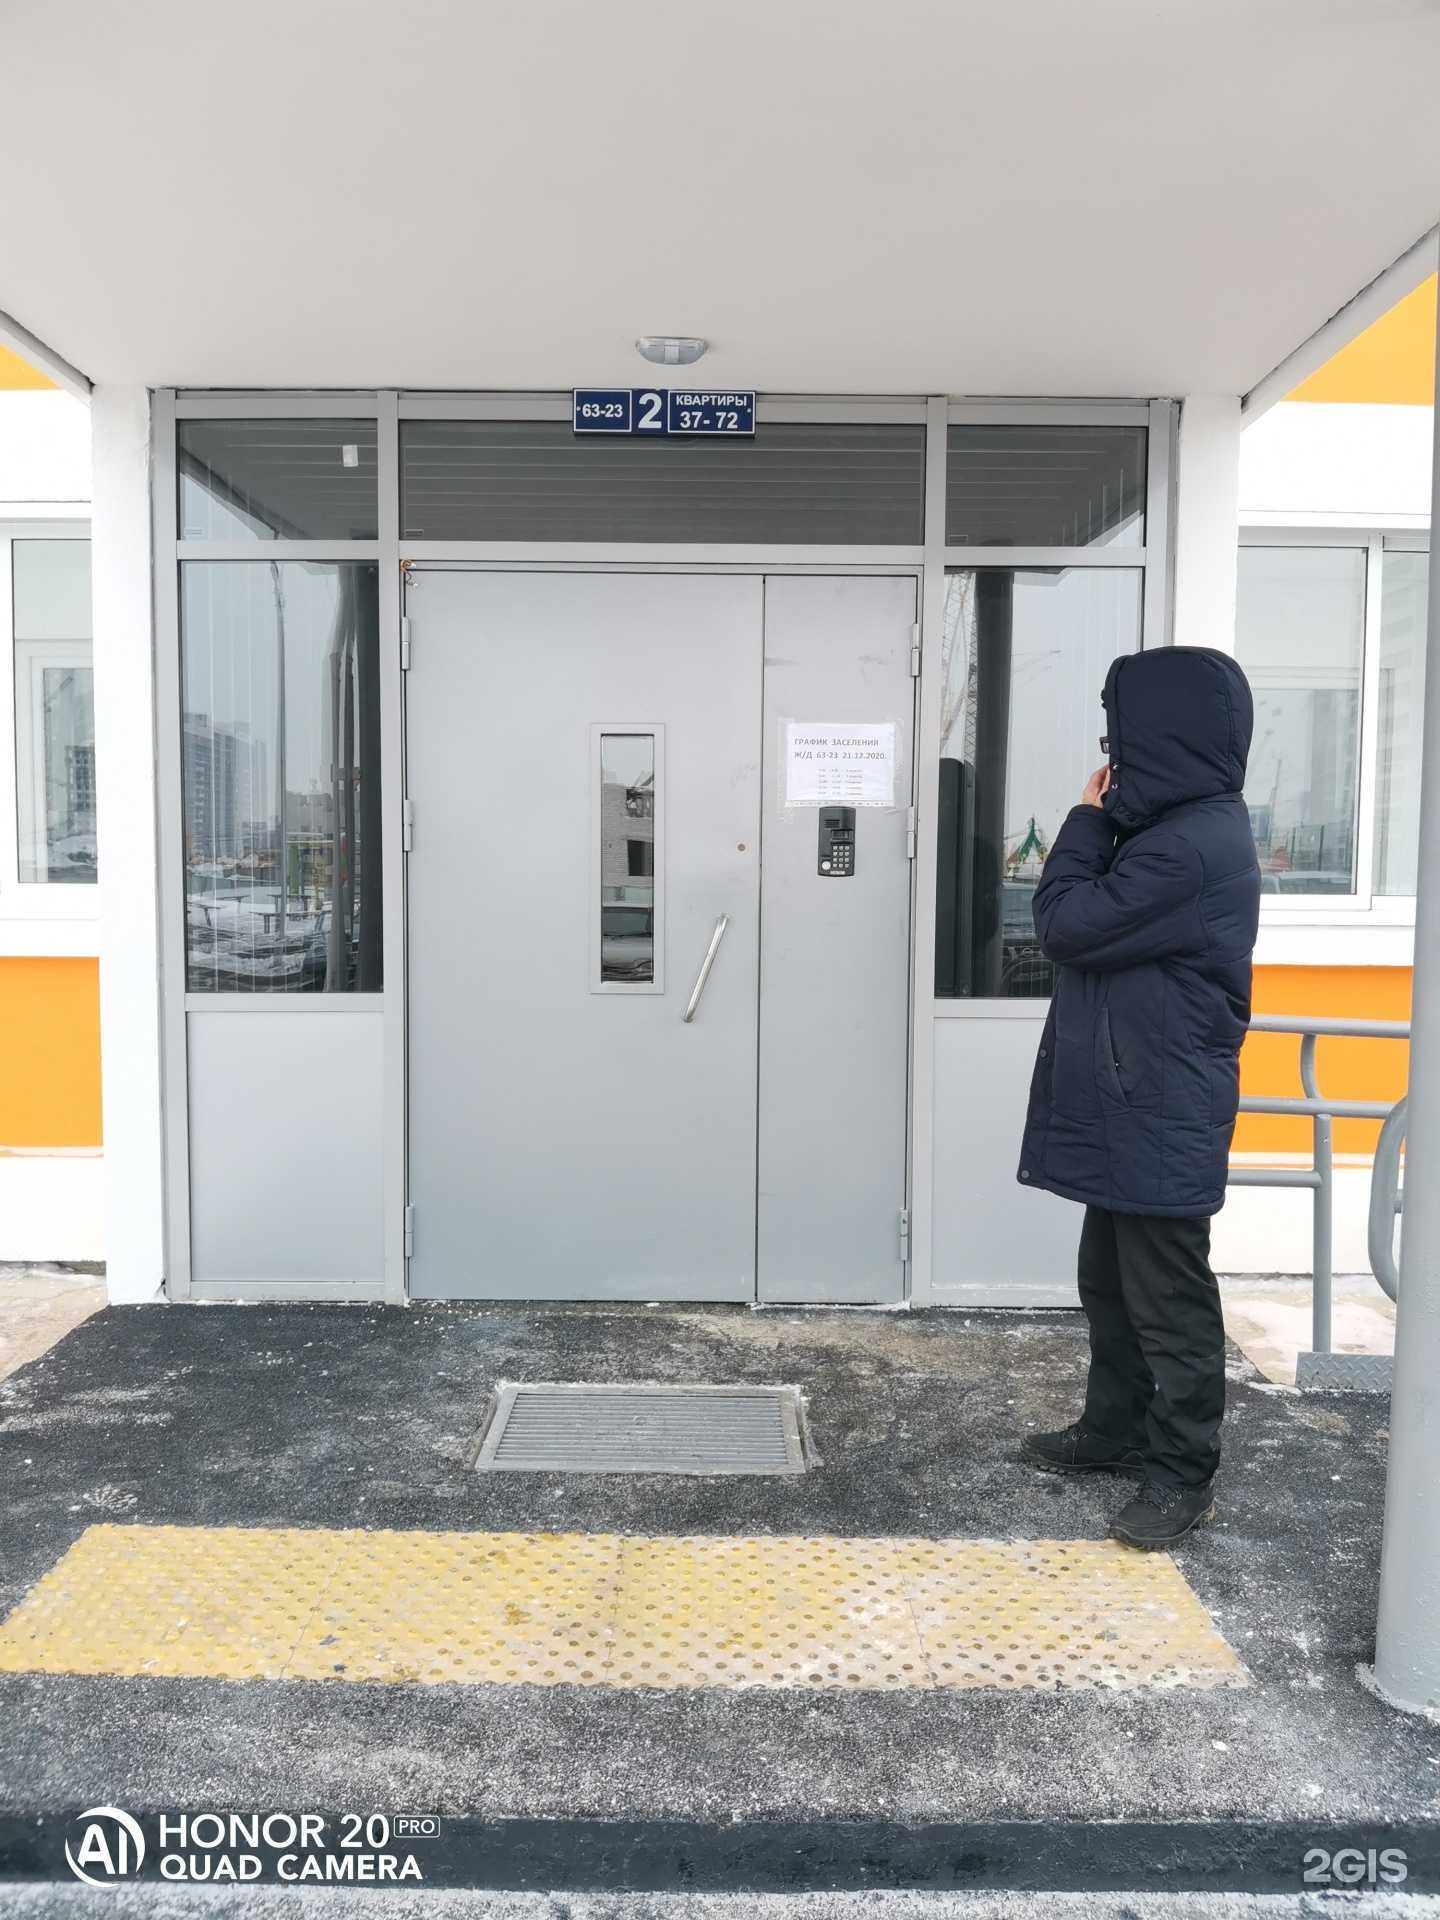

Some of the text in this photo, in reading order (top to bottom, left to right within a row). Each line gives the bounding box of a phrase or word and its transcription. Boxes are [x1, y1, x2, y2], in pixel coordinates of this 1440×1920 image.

[675, 395, 747, 407] КВАРТИРЫ
[582, 404, 623, 418] 63-23
[638, 392, 662, 429] 2
[794, 738, 879, 747] ГРАФИК ЗАСЕЛЕНИЯ
[794, 751, 813, 760] Ж/Д
